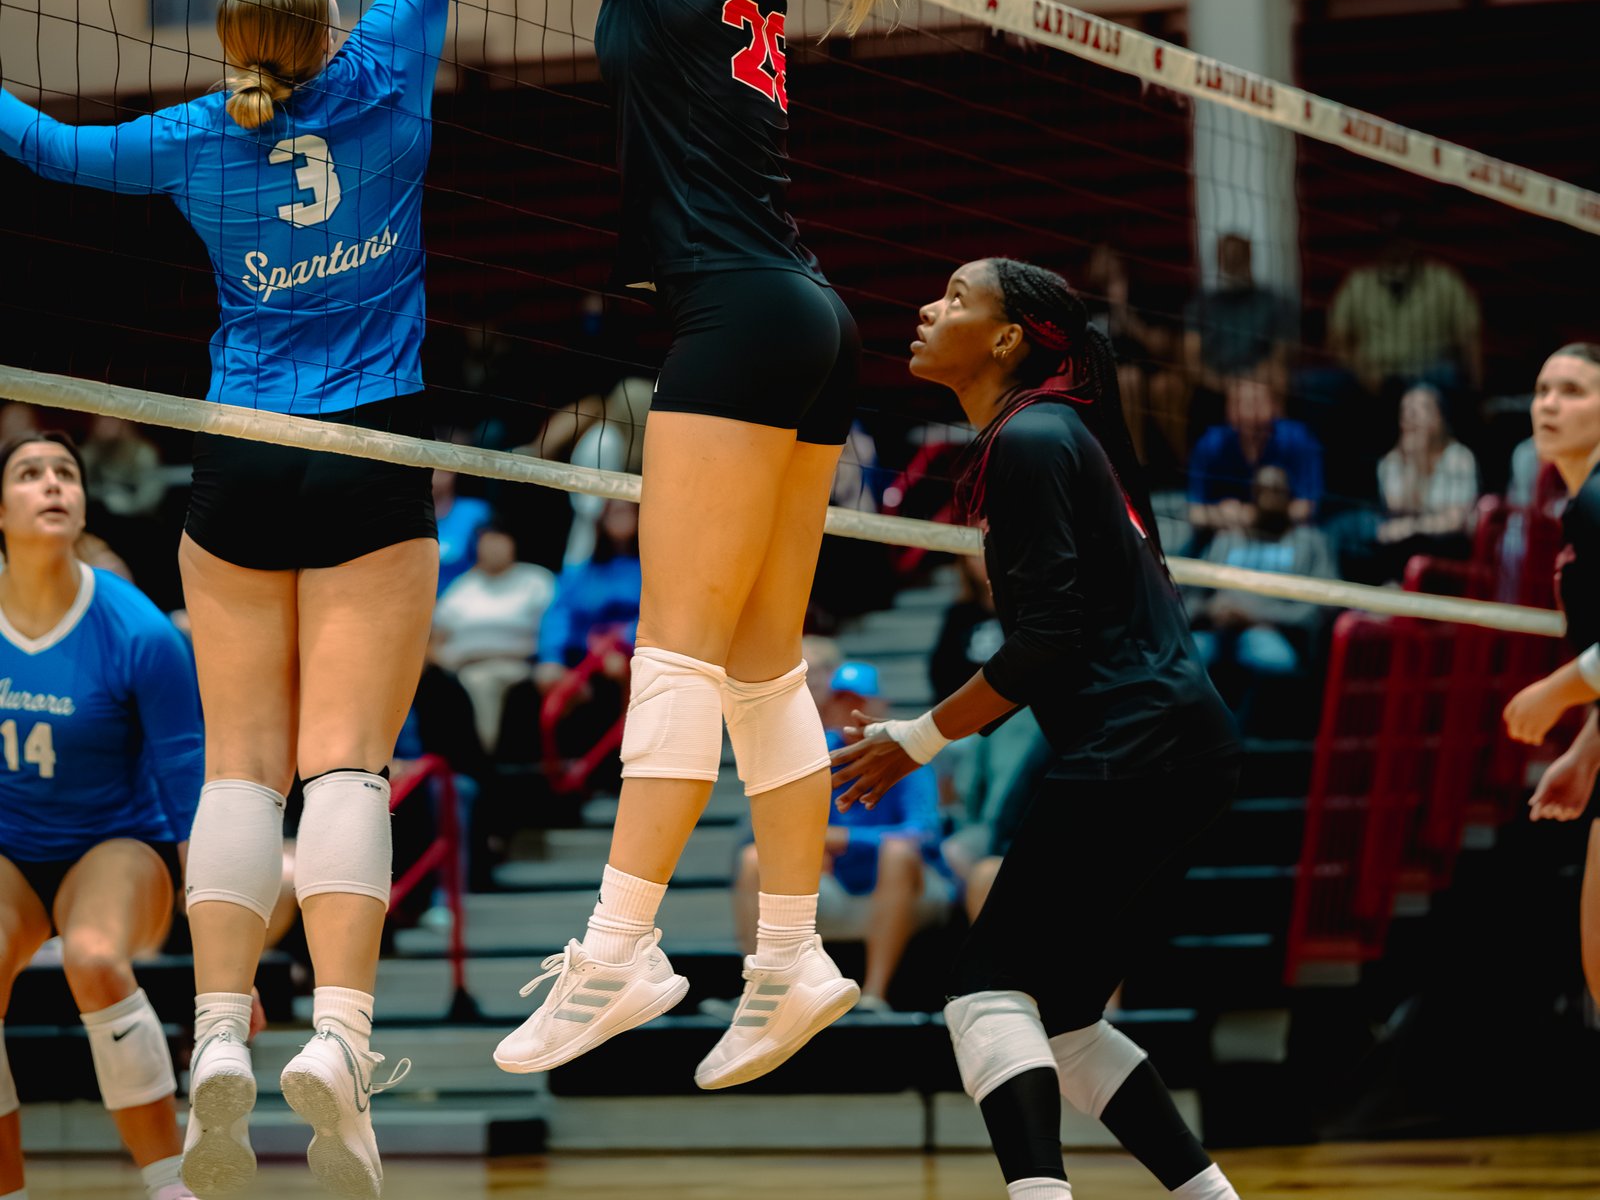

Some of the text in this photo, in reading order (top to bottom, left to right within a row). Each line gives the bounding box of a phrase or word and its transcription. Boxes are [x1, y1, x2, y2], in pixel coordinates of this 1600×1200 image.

[268, 134, 342, 229] 3
[242, 224, 398, 303] Spartans
[0, 718, 57, 779] 14
